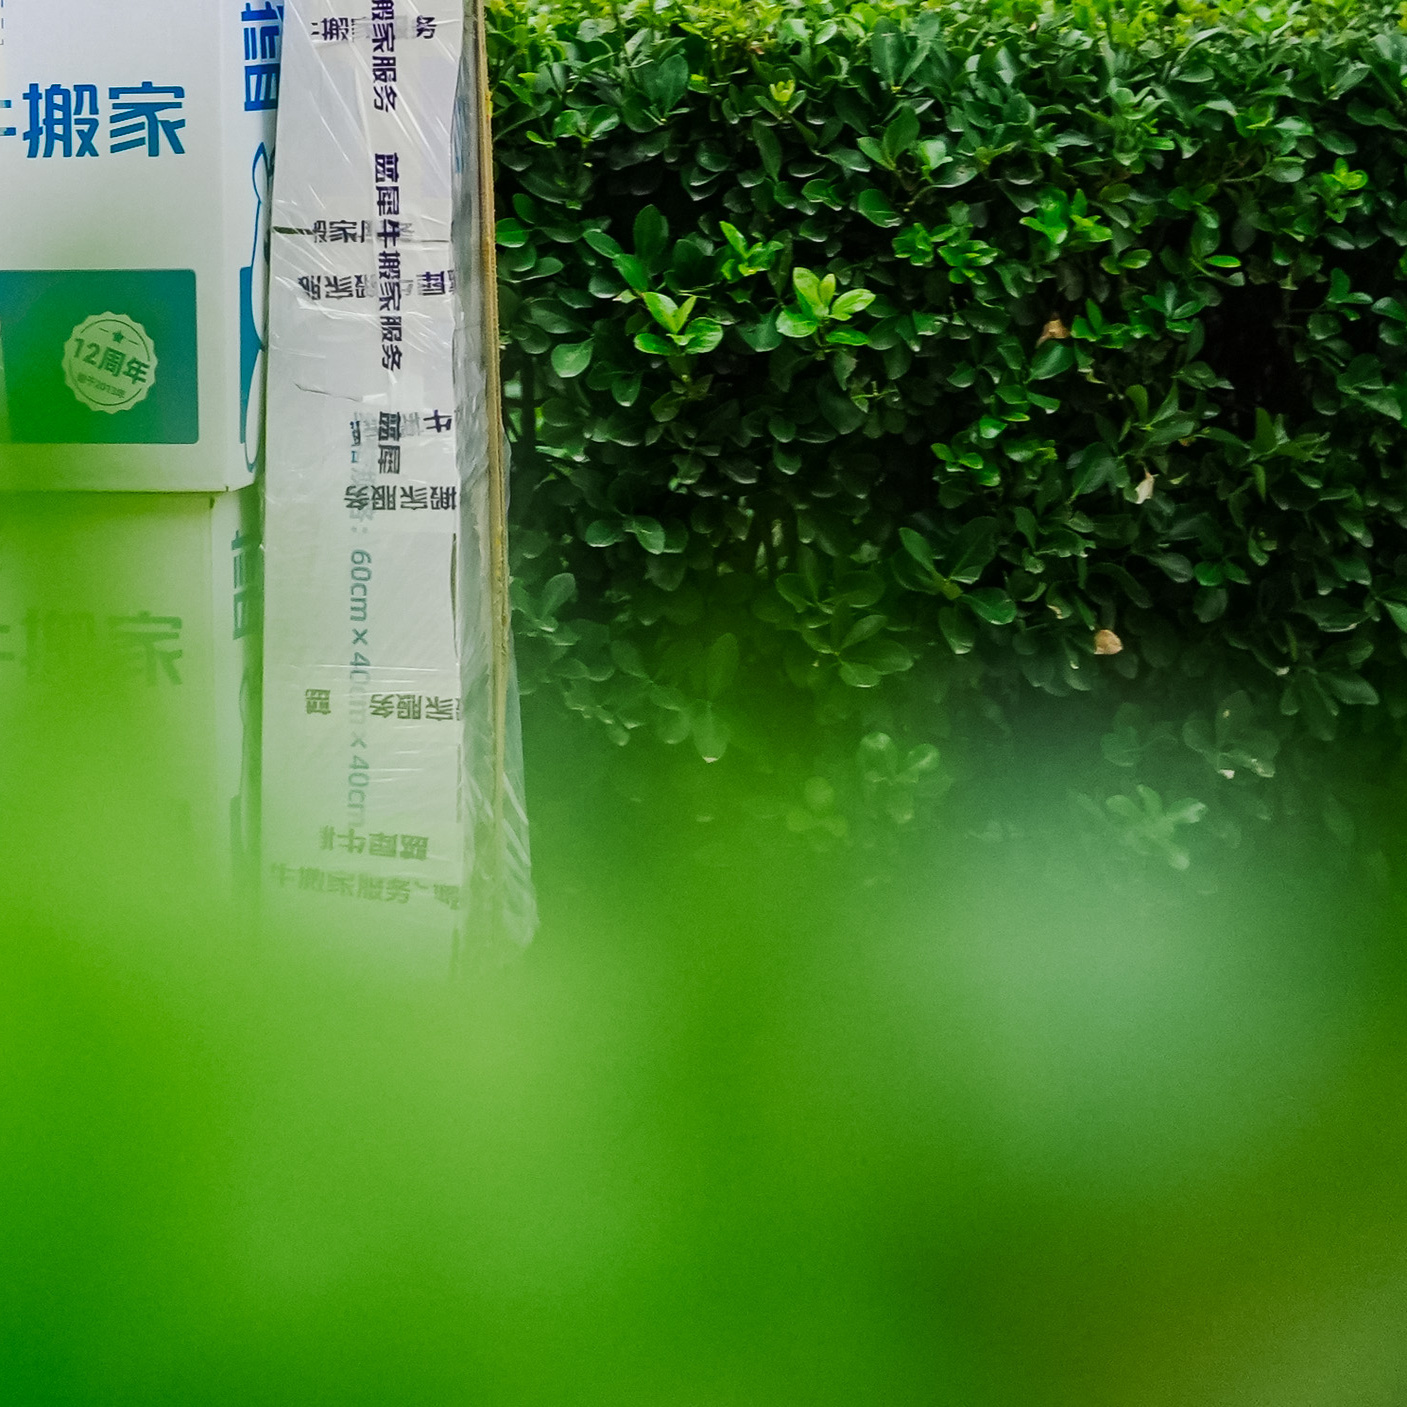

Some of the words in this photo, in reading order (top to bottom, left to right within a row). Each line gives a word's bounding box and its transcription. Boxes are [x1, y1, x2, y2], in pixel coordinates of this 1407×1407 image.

[373, 152, 403, 372] 蓝犀牛搬家服务
[73, 337, 151, 385] 12周年
[344, 485, 457, 511] 搬家服务
[349, 549, 372, 622] 60cm
[368, 693, 461, 722] 家服务
